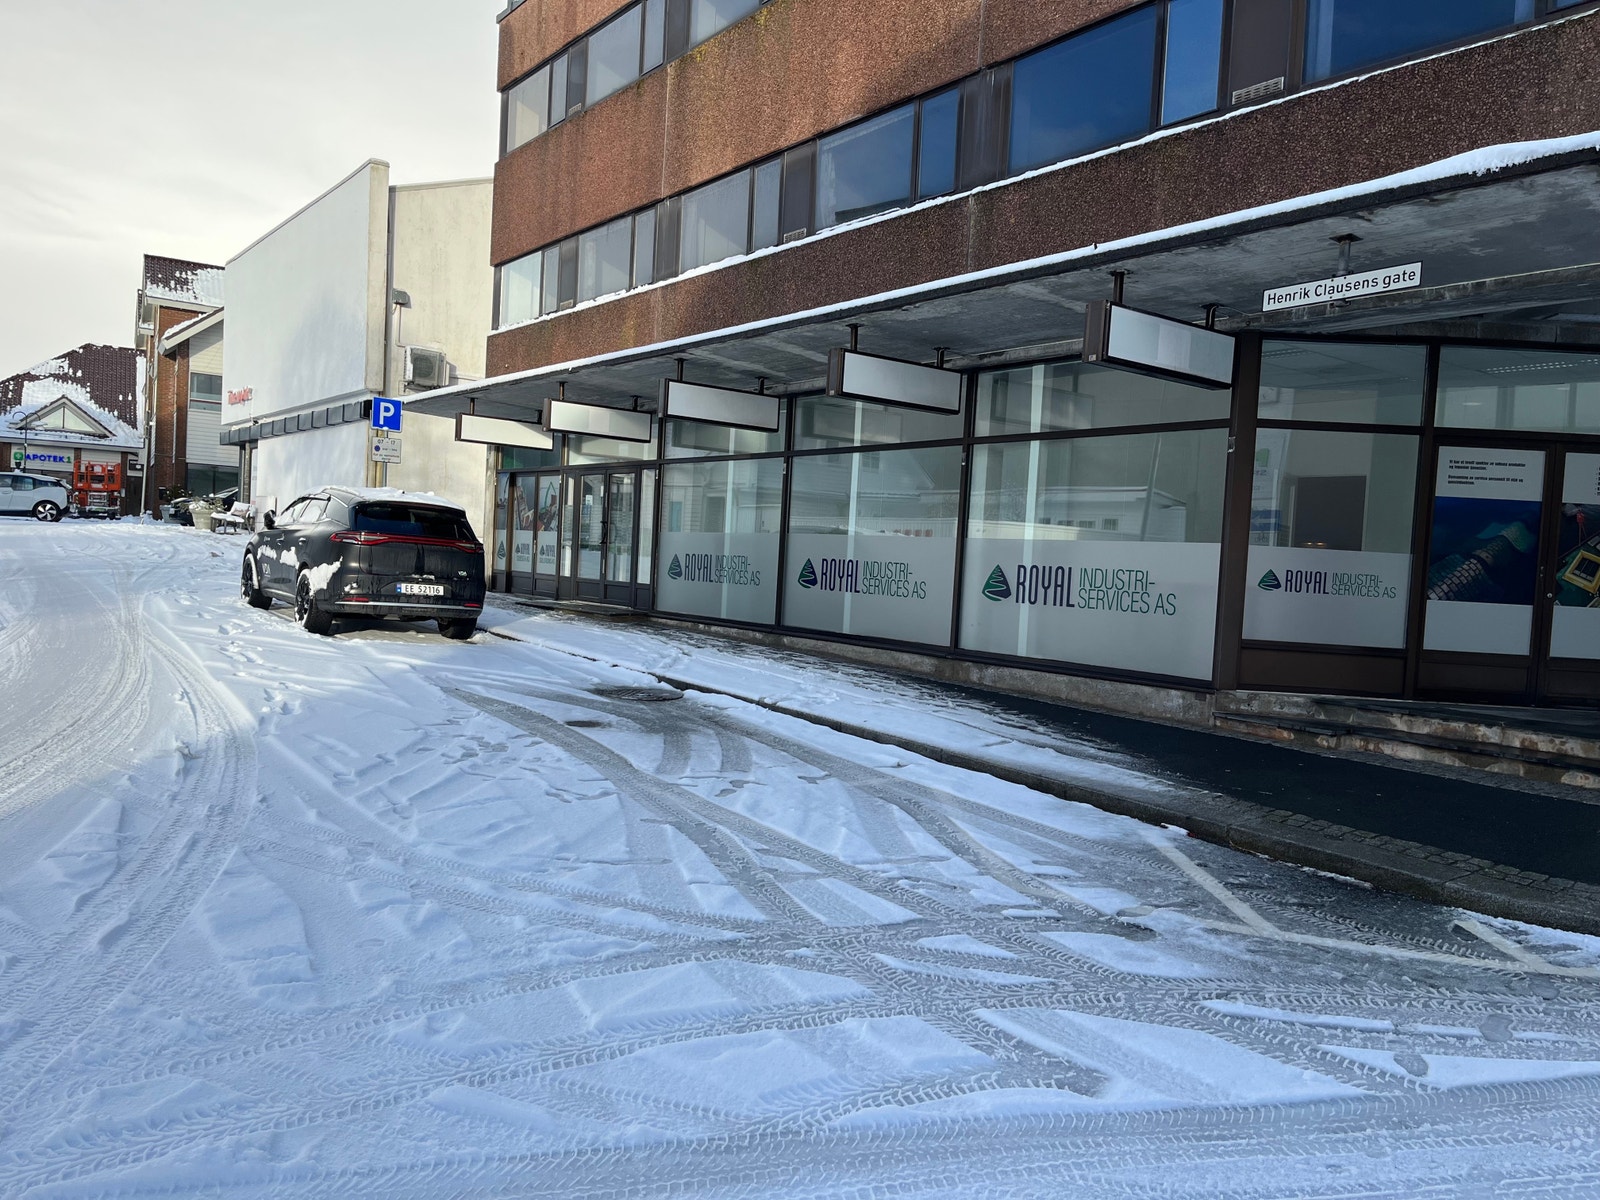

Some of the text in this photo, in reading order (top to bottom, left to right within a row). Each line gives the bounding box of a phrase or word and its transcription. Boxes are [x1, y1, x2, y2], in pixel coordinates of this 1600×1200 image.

[1267, 269, 1416, 305] Henrik Clausens gate
[379, 402, 395, 425] P
[25, 454, 72, 464] APOTEK 1
[684, 553, 713, 583] ROYAL
[714, 554, 751, 570] INDUSTRI-
[862, 560, 913, 580] INDUSTRI-
[714, 569, 760, 587] SERVICES AS
[820, 558, 860, 594] ROYAL
[1015, 564, 1075, 608] ROYAL
[1079, 567, 1156, 592] INDUSTRI-
[1284, 569, 1330, 595] ROYAL
[1332, 572, 1383, 587] INDUSTRI-
[404, 584, 415, 594] EE
[417, 585, 441, 595] 52116
[861, 577, 927, 600] SERVICES AS
[1330, 583, 1397, 599] SERVICES AS
[1077, 587, 1177, 616] SERVICES AS
